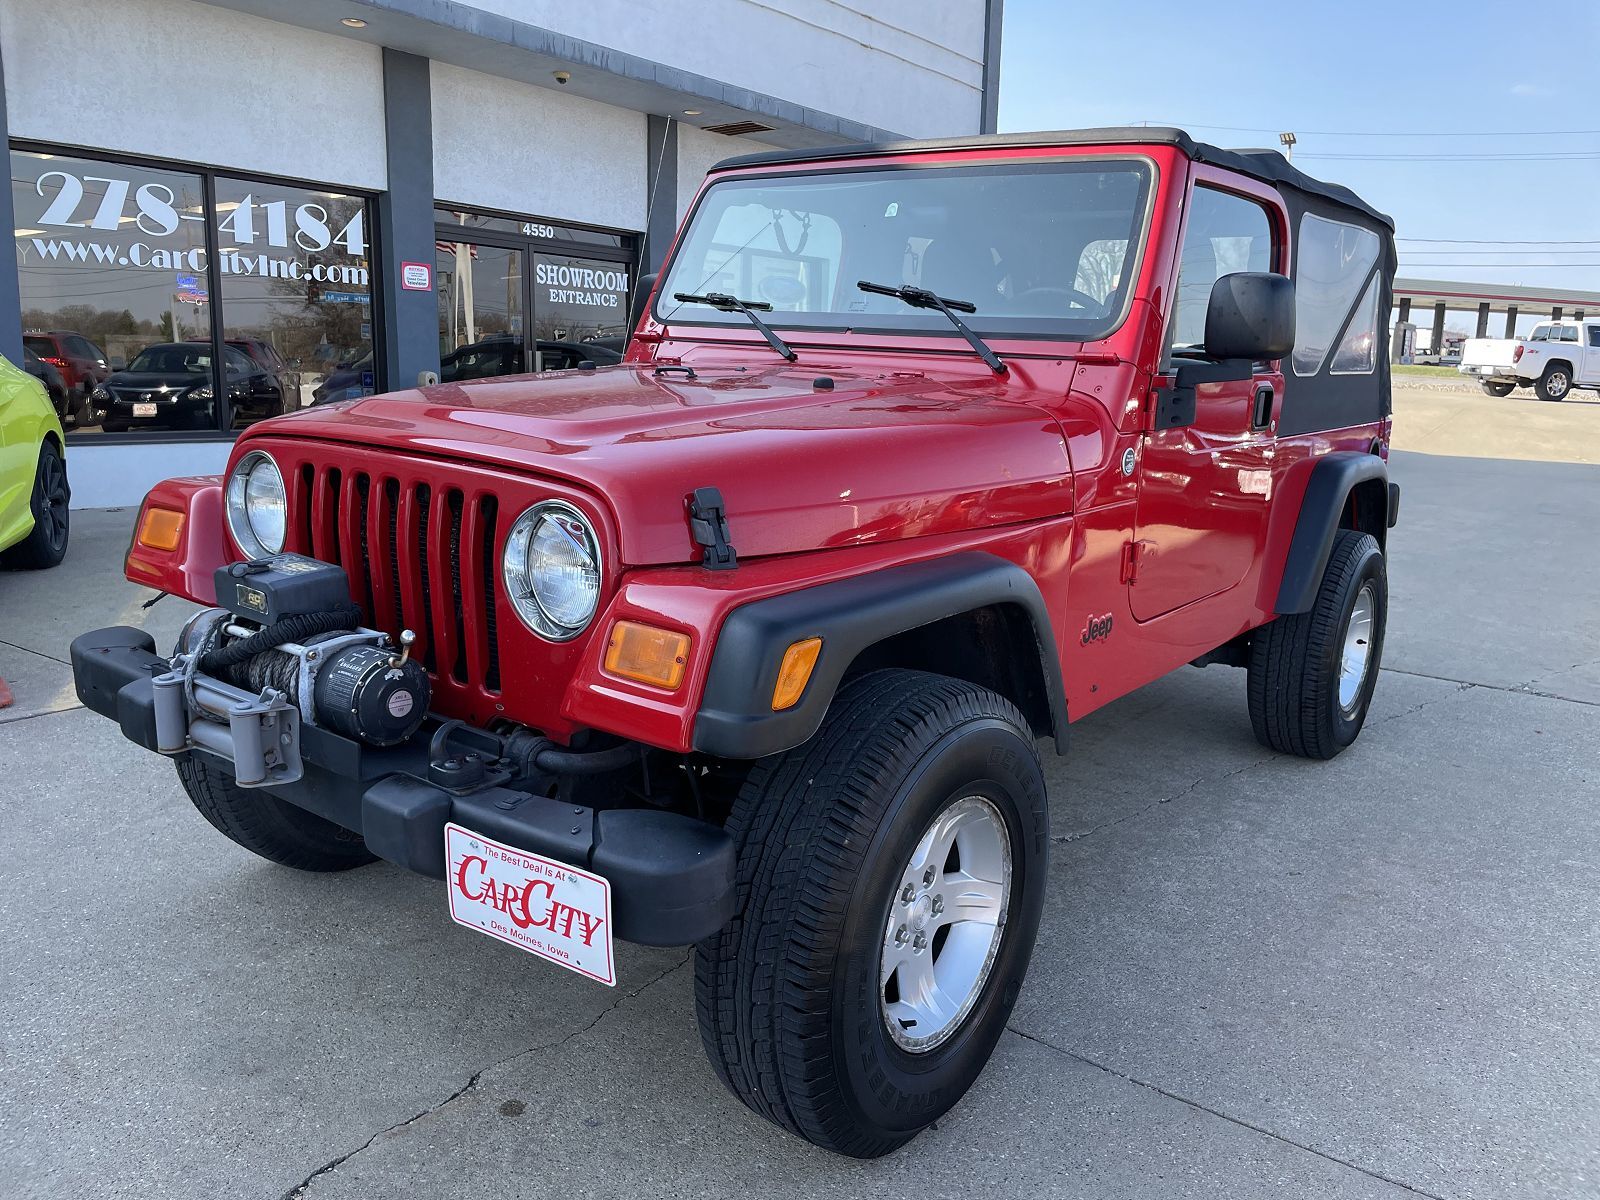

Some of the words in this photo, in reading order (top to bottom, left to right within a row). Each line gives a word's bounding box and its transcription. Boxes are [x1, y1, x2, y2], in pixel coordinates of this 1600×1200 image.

[36, 171, 369, 256] 278-4184
[522, 222, 554, 239] 4550
[32, 238, 369, 286] www.CarCityInc.com
[536, 263, 629, 293] SHOWROOM
[549, 289, 618, 308] ENTRANCE
[1081, 613, 1113, 644] Jeep
[484, 845, 499, 859] The
[501, 852, 521, 867] Best
[523, 859, 543, 874] Deal
[545, 866, 553, 877] Is
[554, 871, 566, 882] At
[490, 920, 508, 934] Des
[510, 928, 545, 950] Moines,
[547, 943, 570, 959] Iowa
